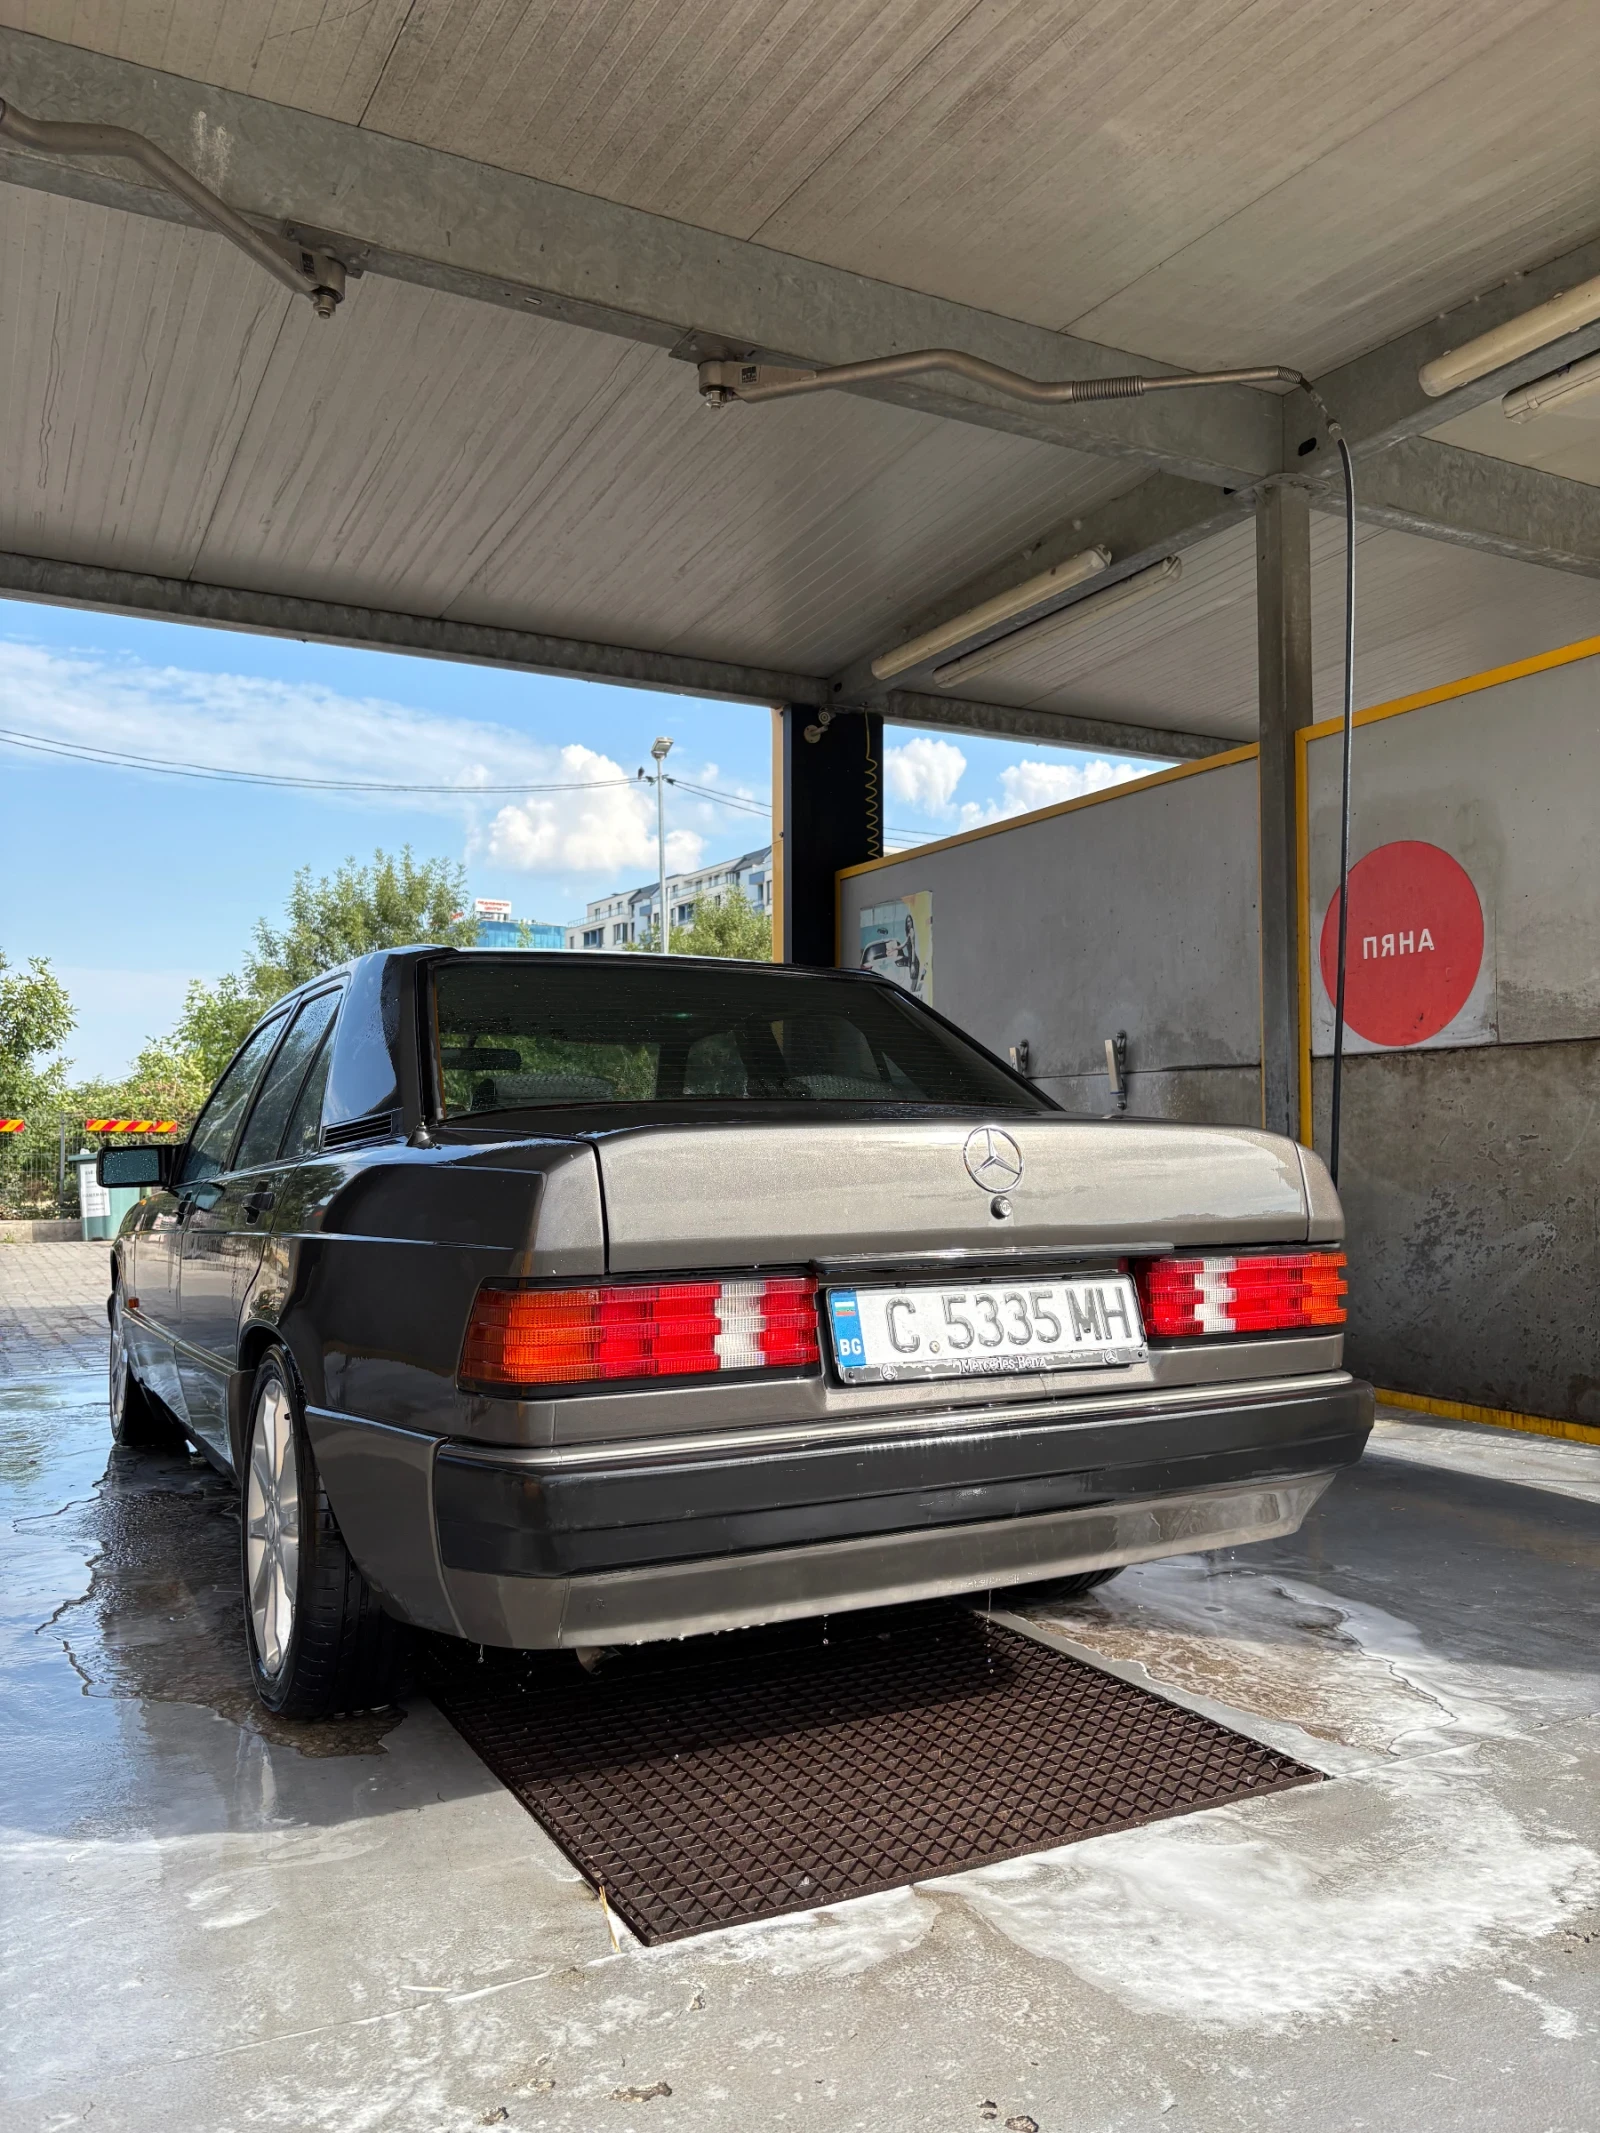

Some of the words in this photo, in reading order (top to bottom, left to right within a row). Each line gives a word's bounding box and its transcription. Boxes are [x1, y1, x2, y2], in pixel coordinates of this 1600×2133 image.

[1363, 928, 1435, 959] ПЯНА
[839, 1337, 862, 1356] BG
[959, 1354, 1047, 1374] Mercedes-Benz
